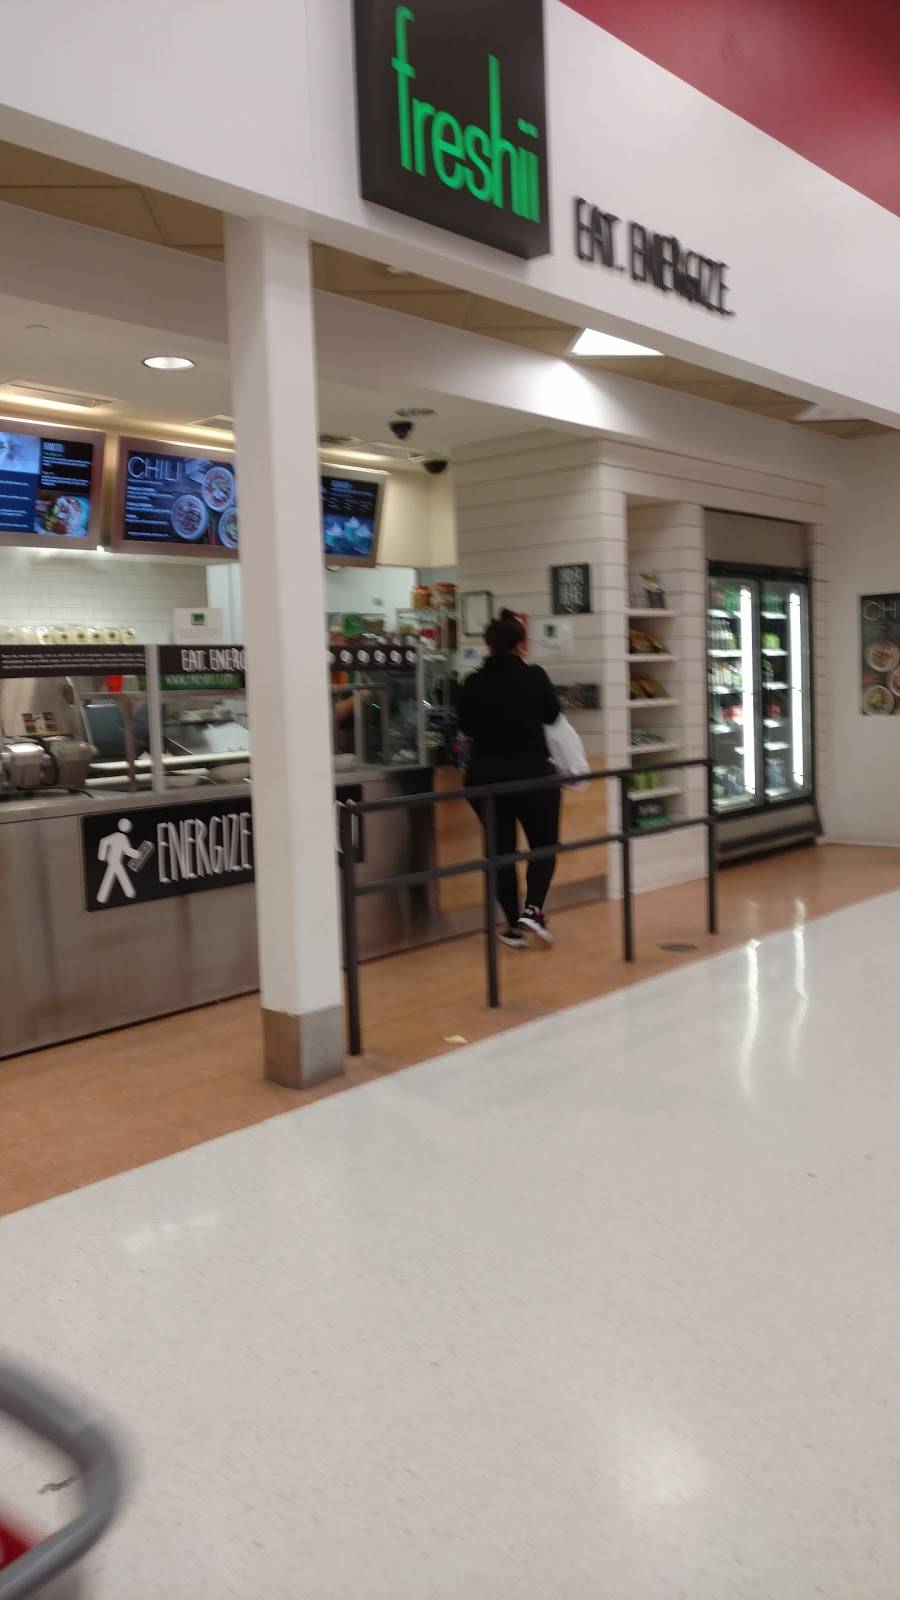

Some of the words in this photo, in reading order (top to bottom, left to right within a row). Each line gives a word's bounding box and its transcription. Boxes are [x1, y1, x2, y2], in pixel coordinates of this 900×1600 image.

[391, 5, 540, 224] freshii
[573, 195, 627, 272] EAT.
[127, 456, 183, 481] CHILI
[156, 812, 252, 884] ENERGIZE
